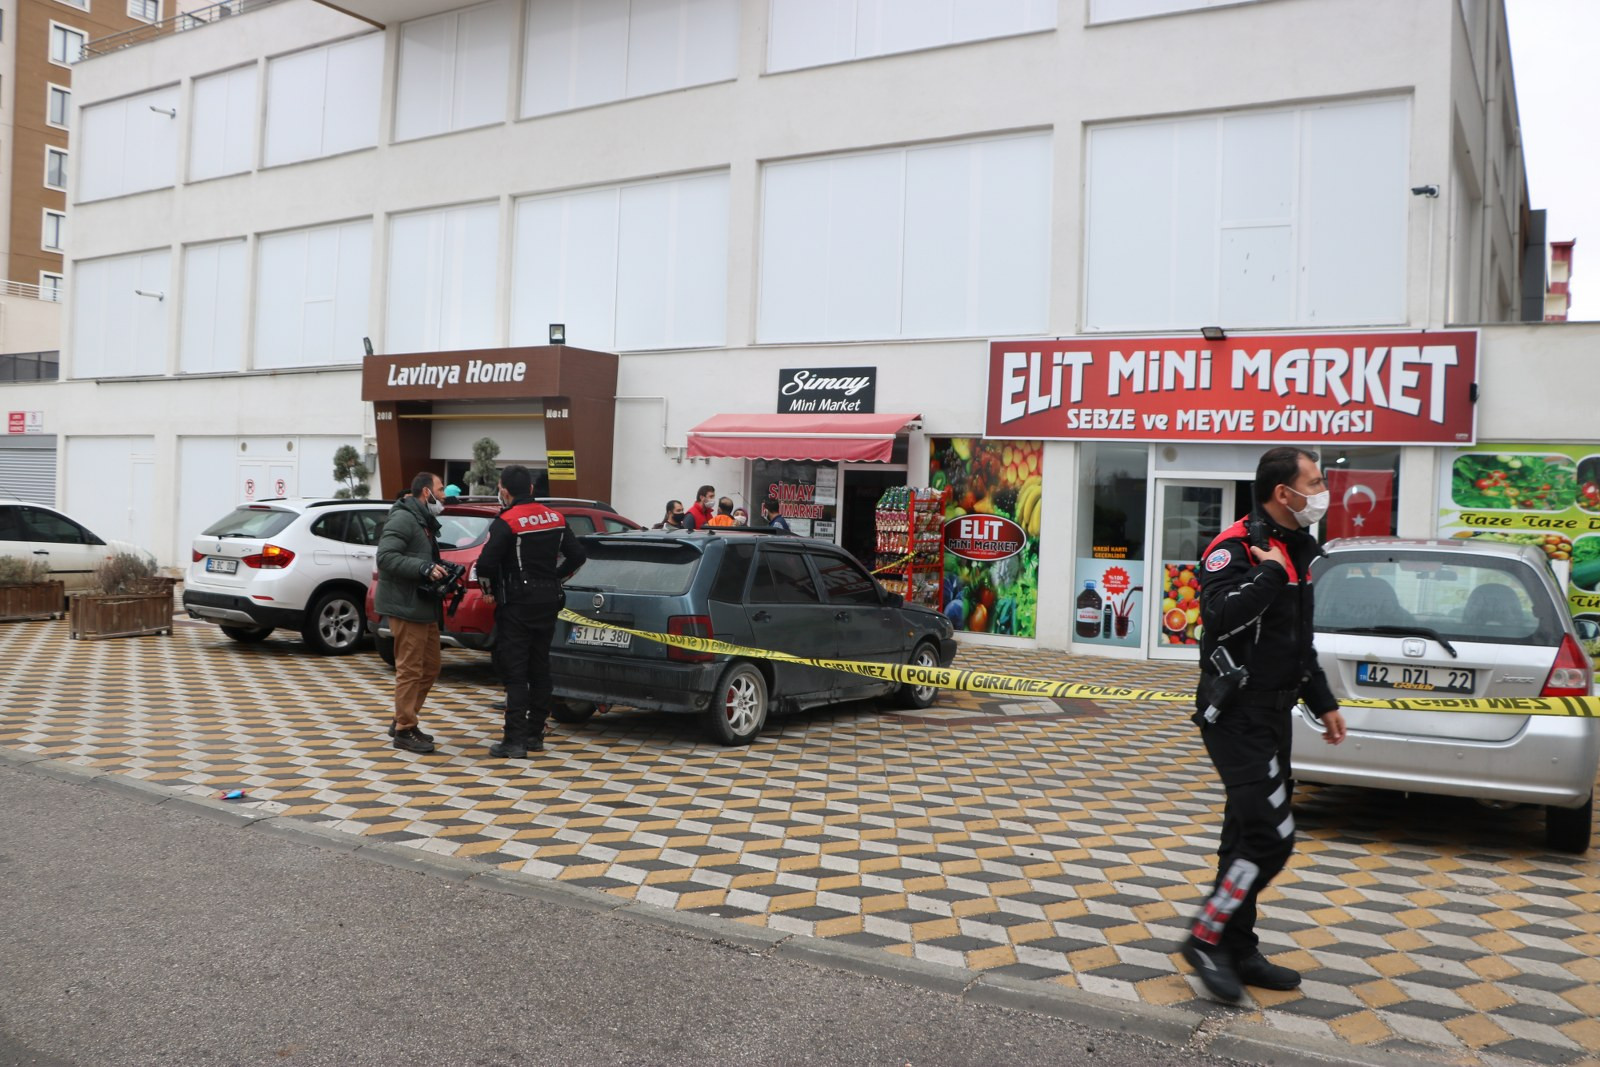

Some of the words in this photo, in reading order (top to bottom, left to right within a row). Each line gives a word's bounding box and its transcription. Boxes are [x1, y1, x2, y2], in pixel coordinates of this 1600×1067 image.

[387, 362, 461, 389] Lavinya
[465, 360, 527, 383] Home
[781, 370, 870, 396] Simay
[1231, 345, 1459, 425] MARKET
[789, 398, 816, 412] Mini
[818, 398, 861, 412] Market
[1066, 408, 1137, 430] SEBZE
[1142, 413, 1169, 431] ve
[1176, 408, 1255, 434] MEYVE
[1262, 404, 1374, 435] DÜNYASI
[1458, 512, 1513, 527] Taze
[1522, 514, 1578, 529] Taze
[974, 540, 1018, 553] MARKET
[576, 627, 588, 639] 51
[593, 628, 606, 641] LC
[610, 630, 630, 643] 380
[1368, 666, 1389, 683] 42
[1448, 671, 1469, 690] 22
